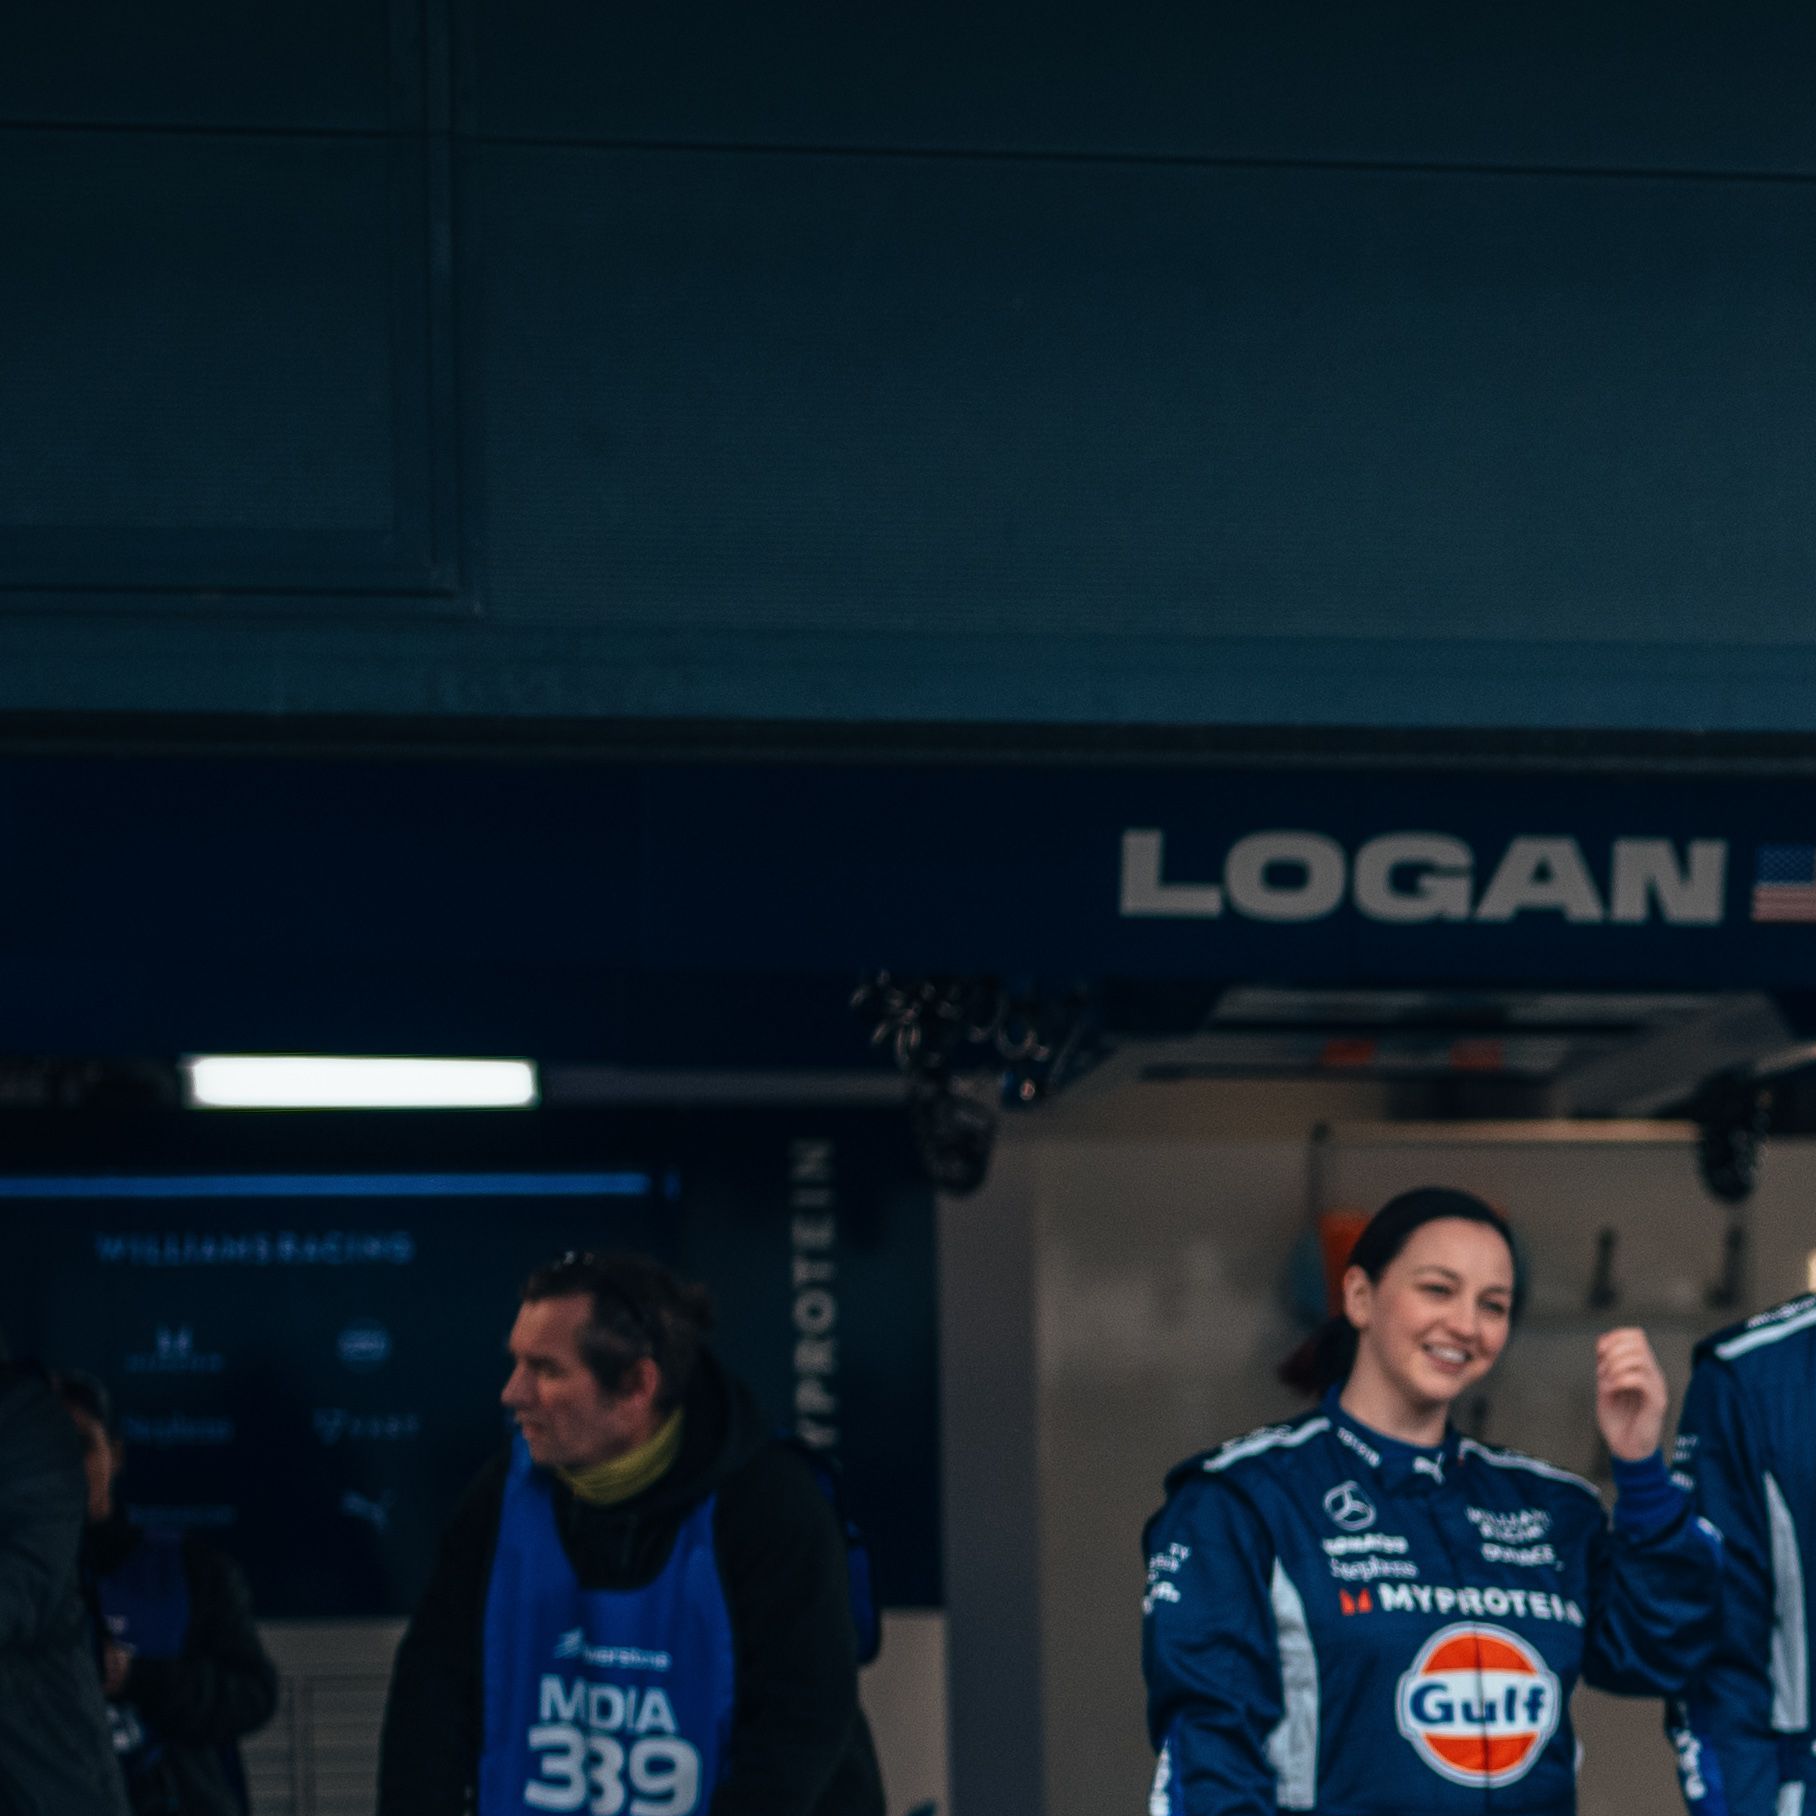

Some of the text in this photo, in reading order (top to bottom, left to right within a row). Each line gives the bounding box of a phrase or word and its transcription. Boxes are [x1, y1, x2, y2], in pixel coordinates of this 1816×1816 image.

[1119, 829, 1727, 925] LOGAN
[539, 1672, 679, 1735] MDIA
[1409, 1681, 1545, 1727] Gulf
